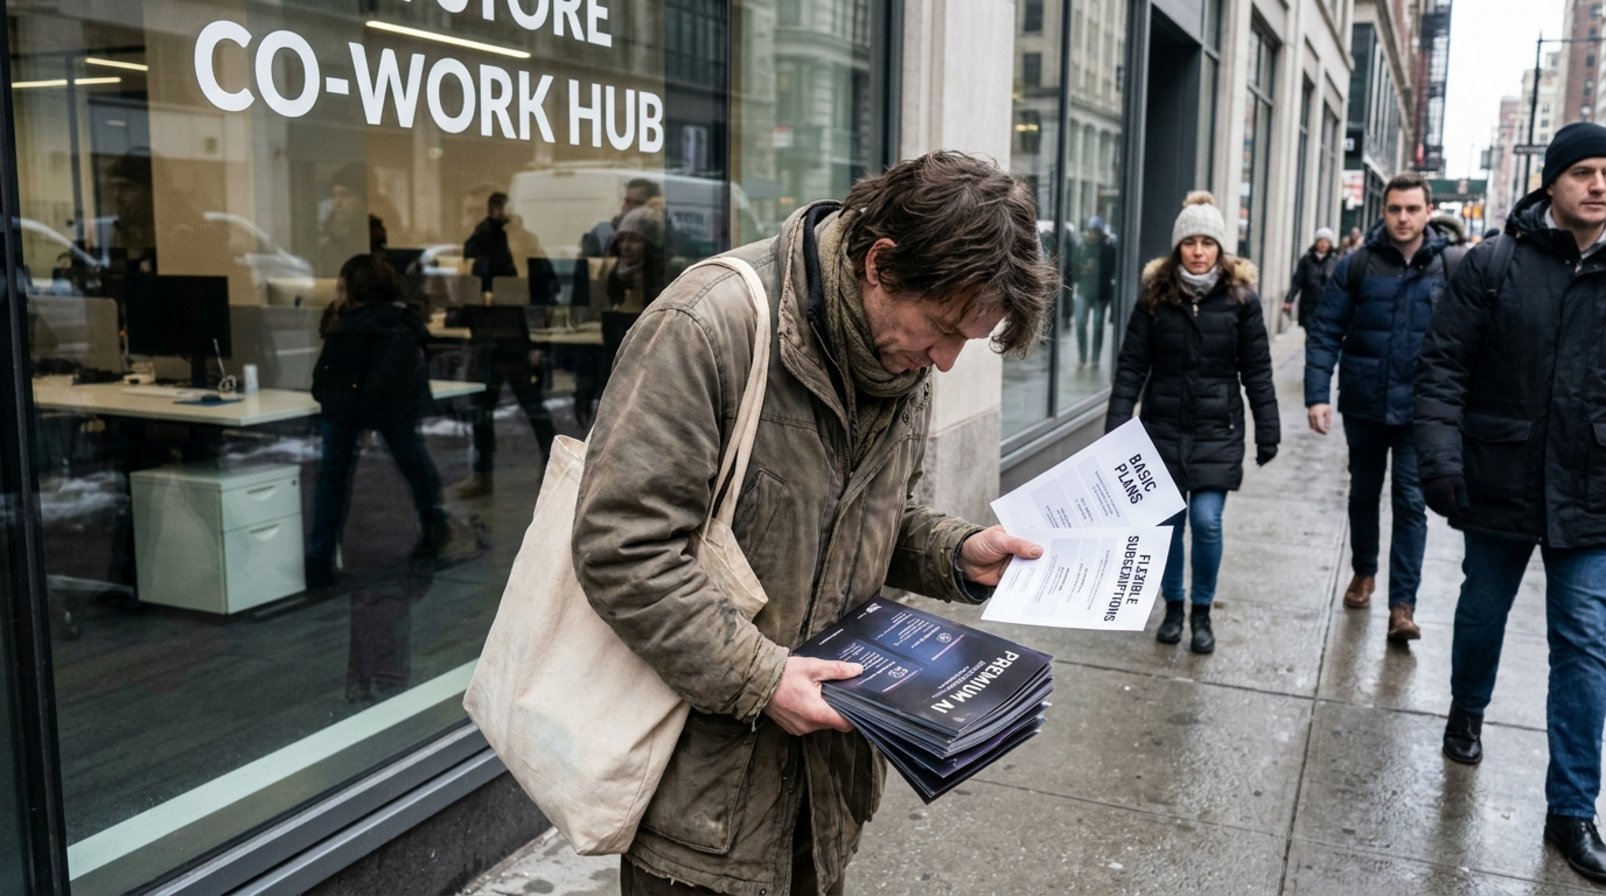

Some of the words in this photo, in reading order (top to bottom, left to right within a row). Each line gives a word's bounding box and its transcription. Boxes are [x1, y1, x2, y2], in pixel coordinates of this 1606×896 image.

[194, 20, 556, 144] CO-WORK
[568, 79, 665, 154] HUB
[1114, 463, 1143, 504] PLANS
[949, 650, 1020, 703] PREMIUM
[931, 699, 955, 714] AI
